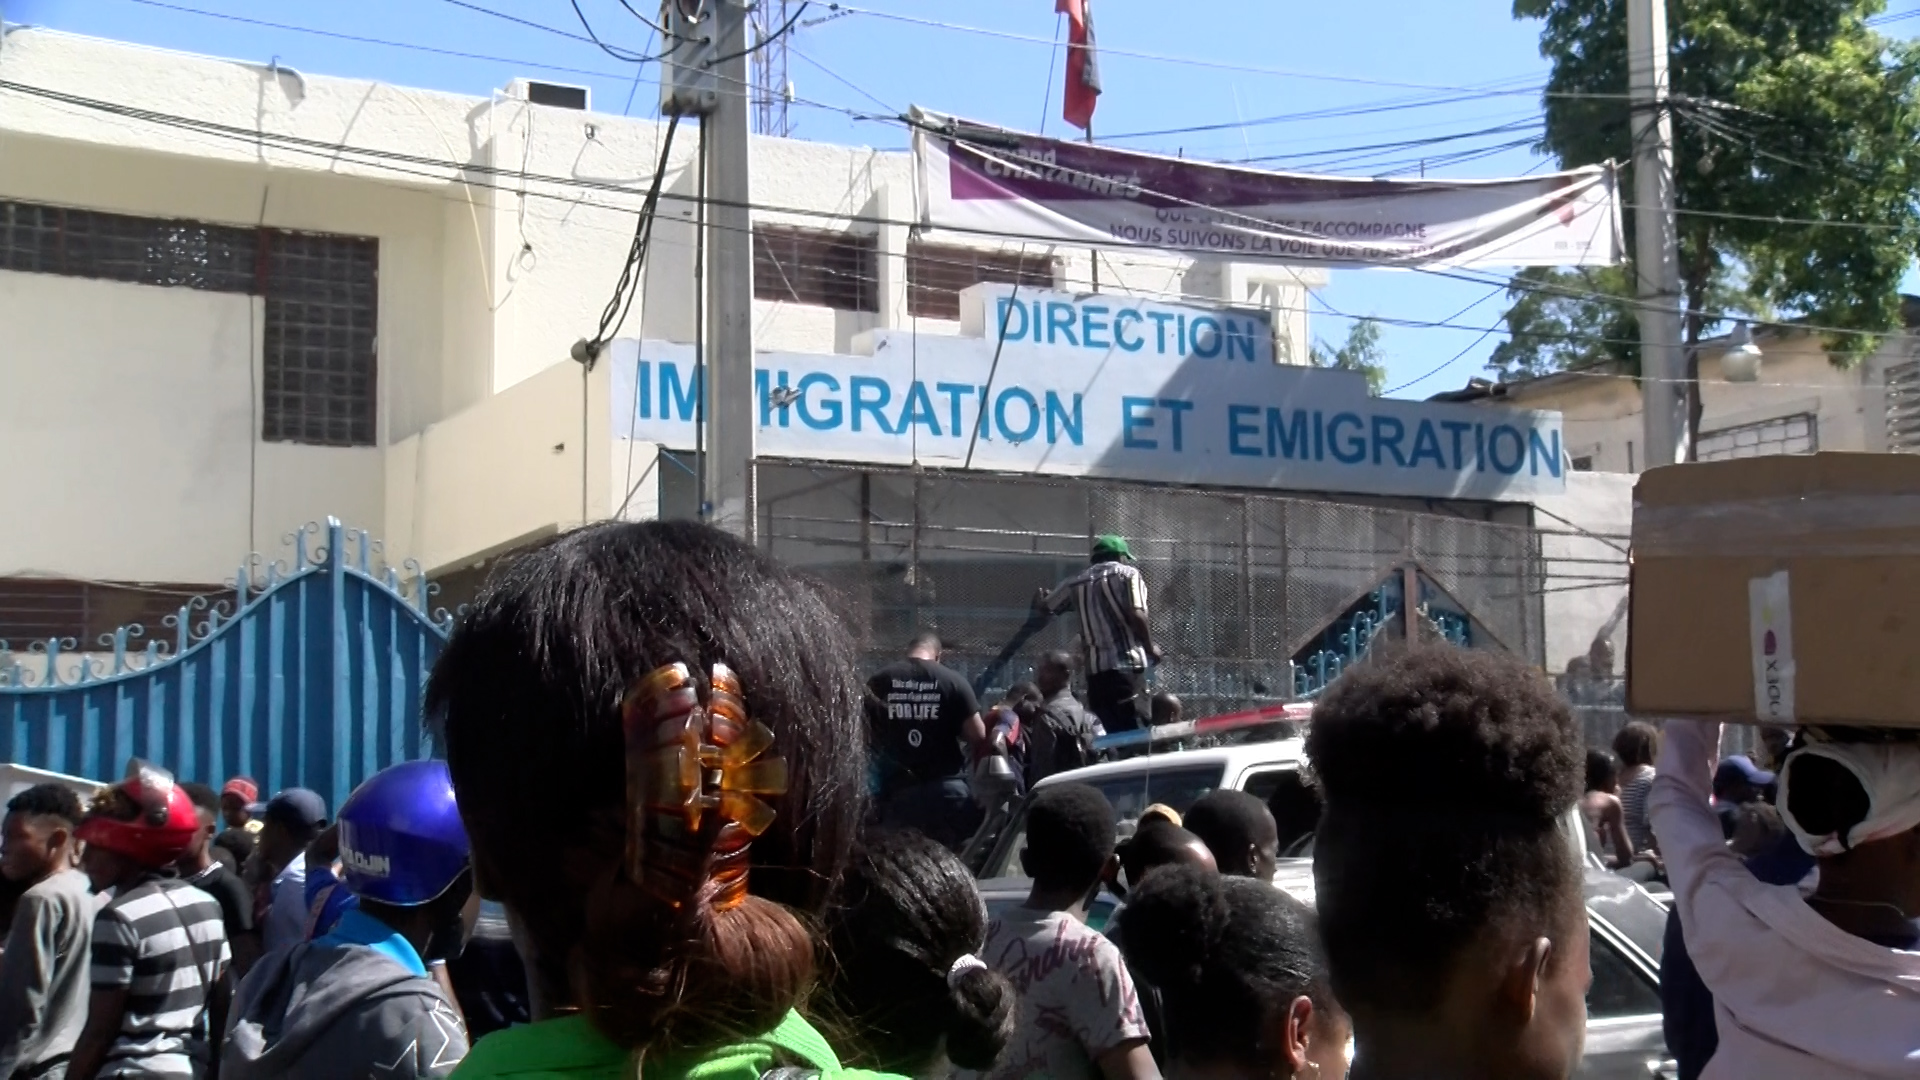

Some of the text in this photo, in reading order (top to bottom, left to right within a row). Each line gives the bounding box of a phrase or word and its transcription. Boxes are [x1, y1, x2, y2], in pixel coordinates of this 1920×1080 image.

[1110, 223, 1162, 242] NOUS
[1167, 228, 1246, 250] SUIVONS
[1251, 236, 1273, 252] LA
[1279, 238, 1317, 255] VOIE
[997, 296, 1254, 363] DIRECTION
[1122, 395, 1193, 453] ET
[1229, 403, 1561, 478] EMIGRATION
[888, 703, 940, 720] FOR LIFE
